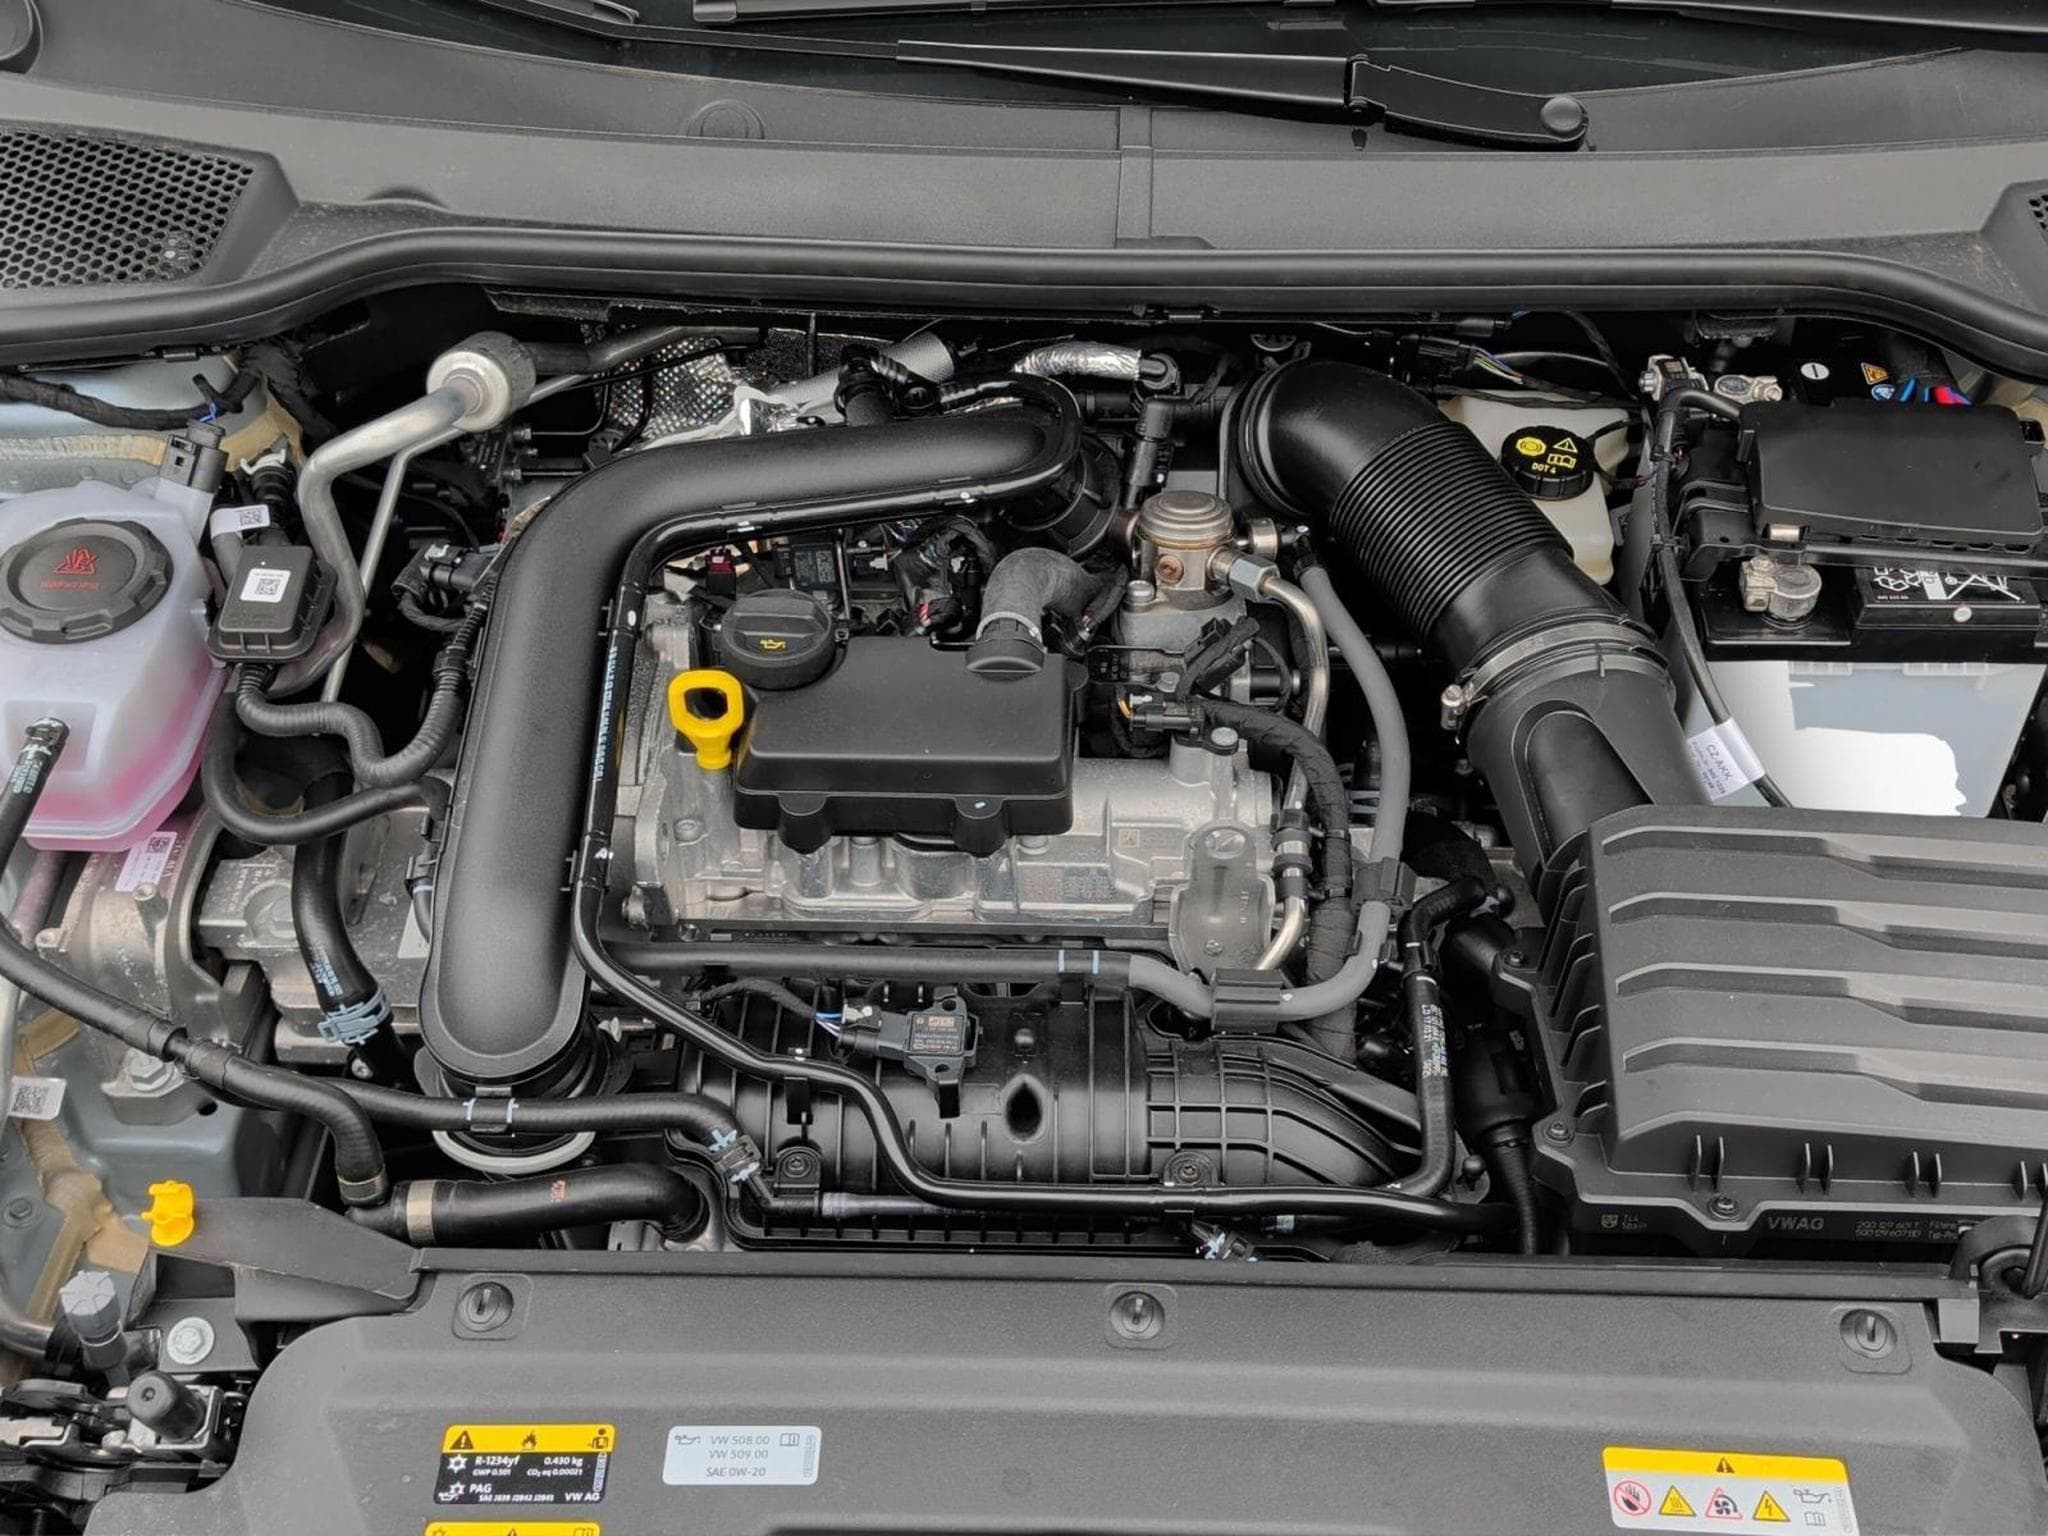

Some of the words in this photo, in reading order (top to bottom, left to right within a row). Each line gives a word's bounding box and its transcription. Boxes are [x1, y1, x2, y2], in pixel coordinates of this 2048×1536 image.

[1531, 462, 1550, 473] DOT
[1550, 466, 1557, 474] 4
[711, 1435, 729, 1445] VW
[708, 1449, 728, 1459] VW
[474, 1455, 520, 1468] R-1234yf
[544, 1456, 570, 1466] 0.430
[571, 1456, 584, 1468] kg
[705, 1467, 727, 1477] SAE
[728, 1467, 767, 1477] 0W-20
[469, 1483, 492, 1494] PAG
[564, 1492, 583, 1501] VW
[584, 1492, 601, 1501] AG
